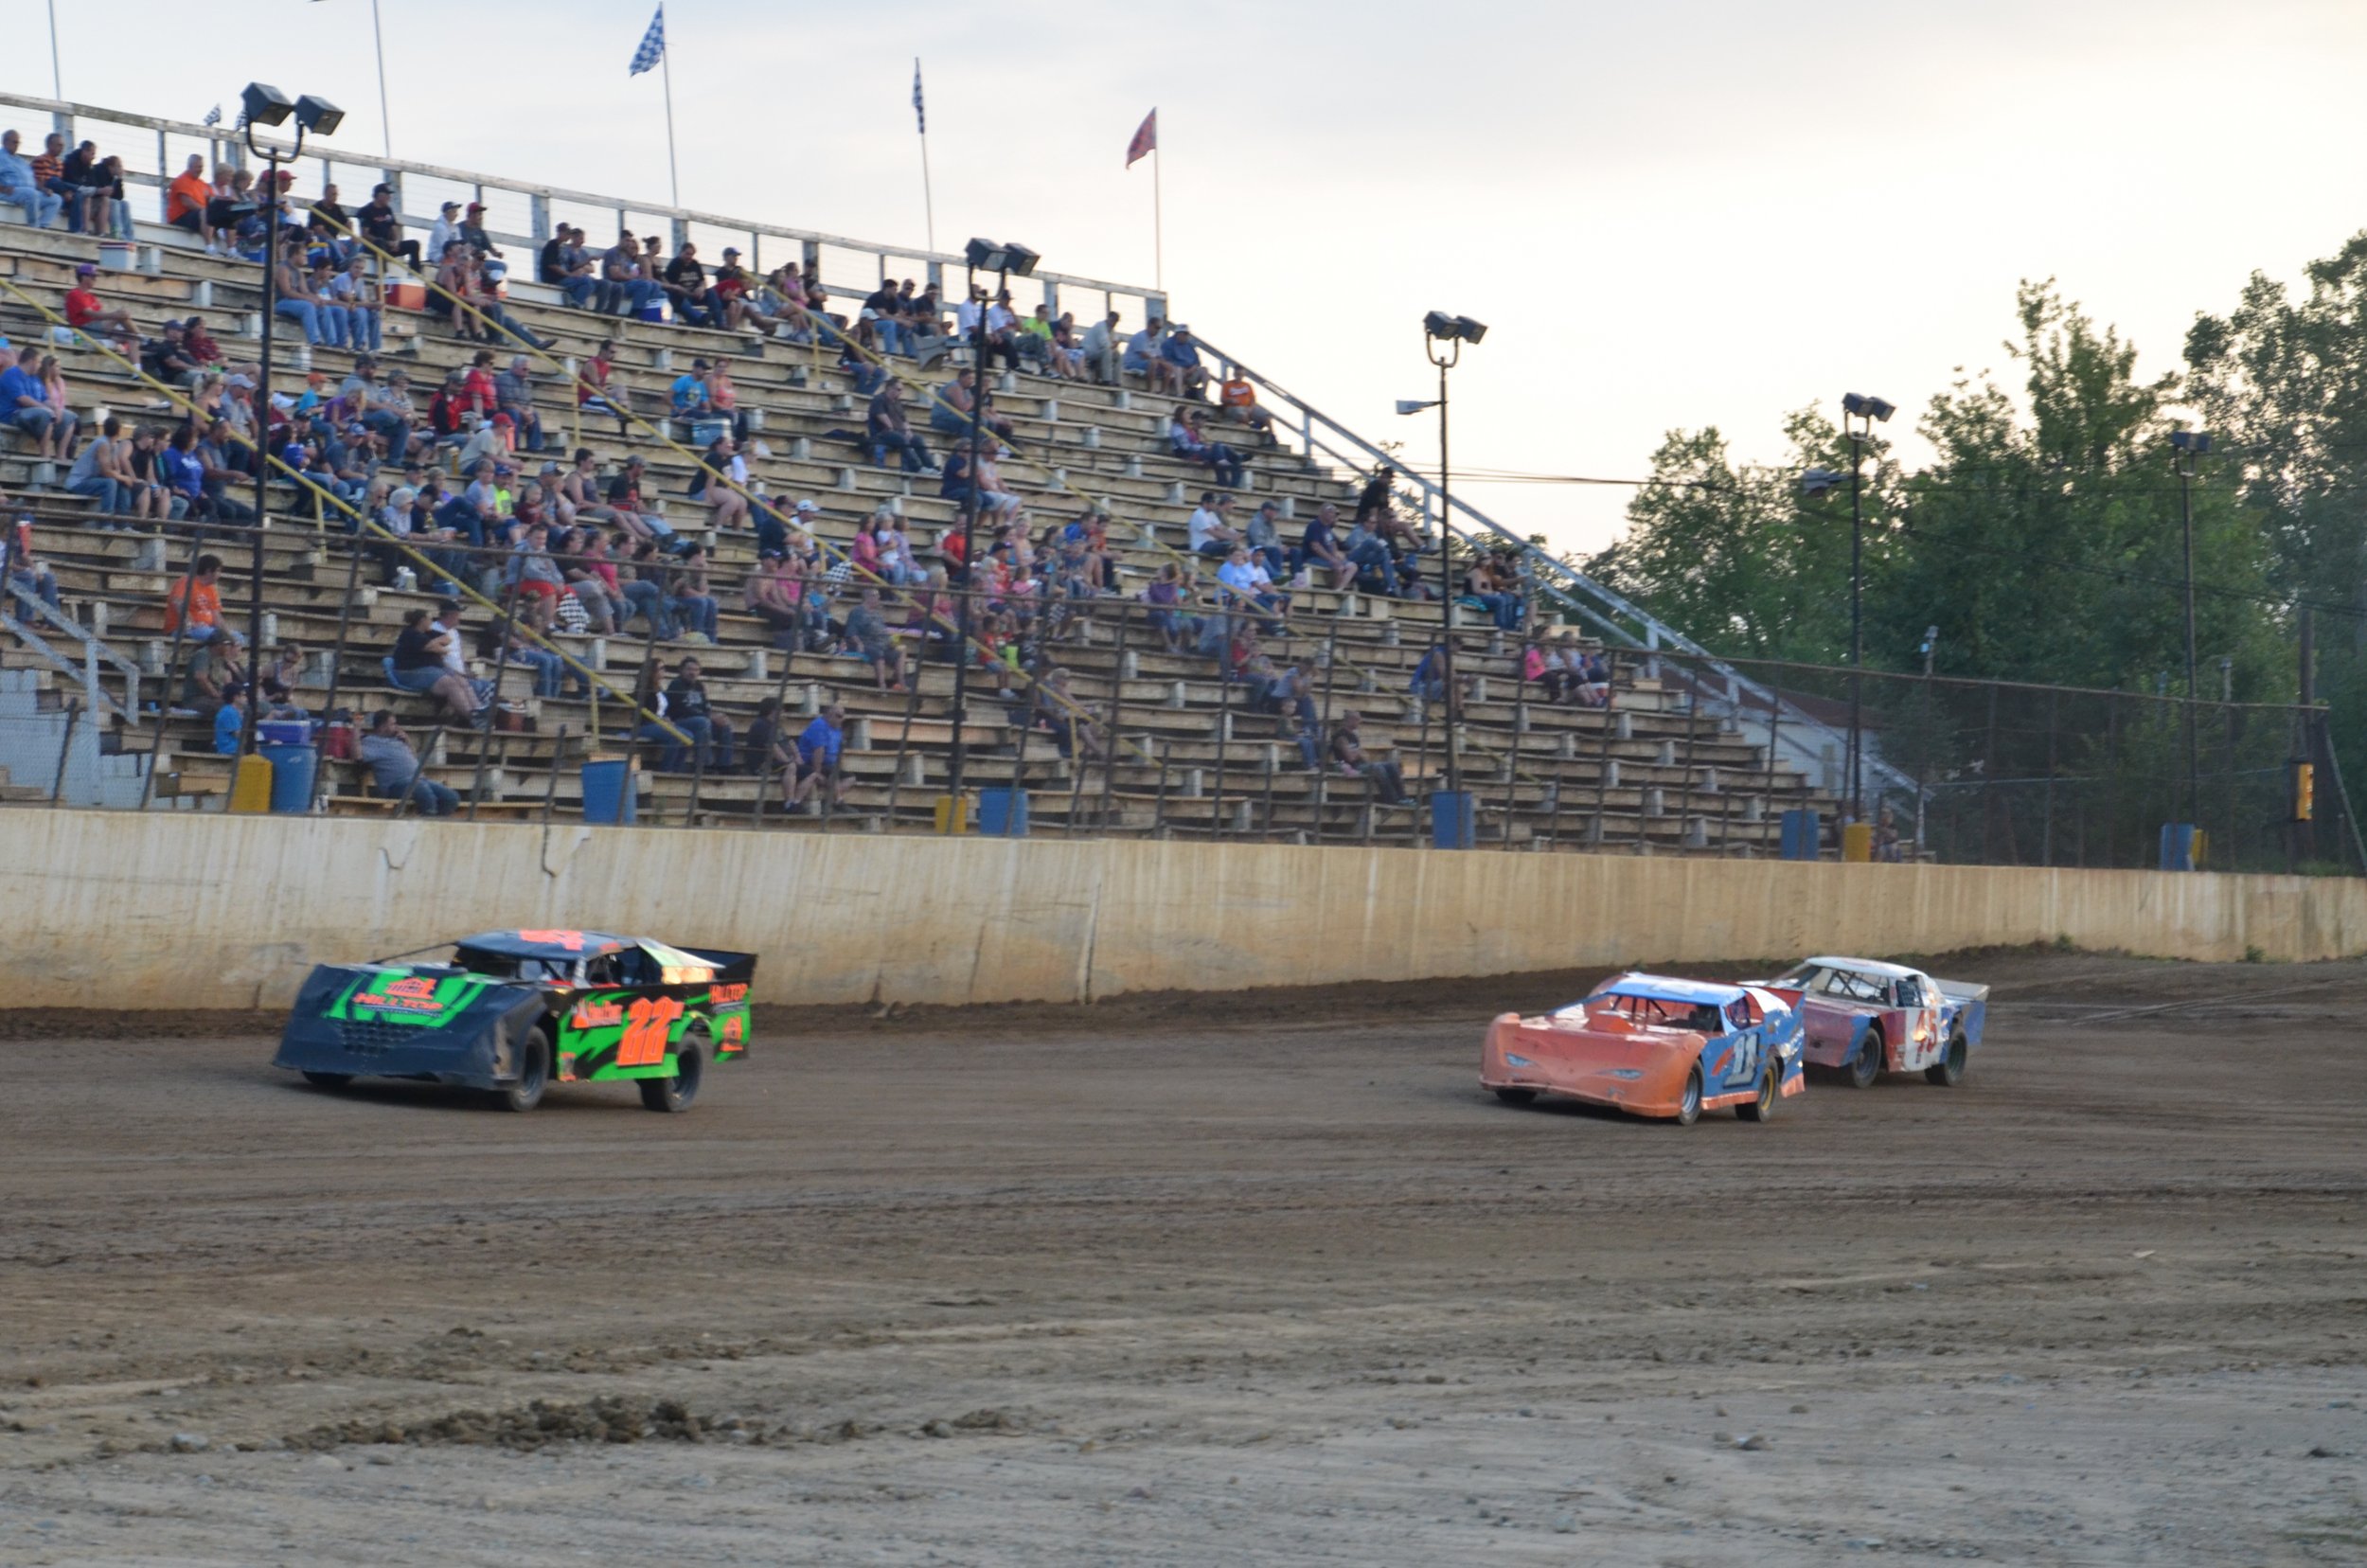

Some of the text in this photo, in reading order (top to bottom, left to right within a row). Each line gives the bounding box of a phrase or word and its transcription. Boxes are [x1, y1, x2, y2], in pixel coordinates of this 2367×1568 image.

[352, 991, 444, 1011] HILLTOP
[709, 983, 748, 1004] HILLTOP
[615, 995, 673, 1066] 22
